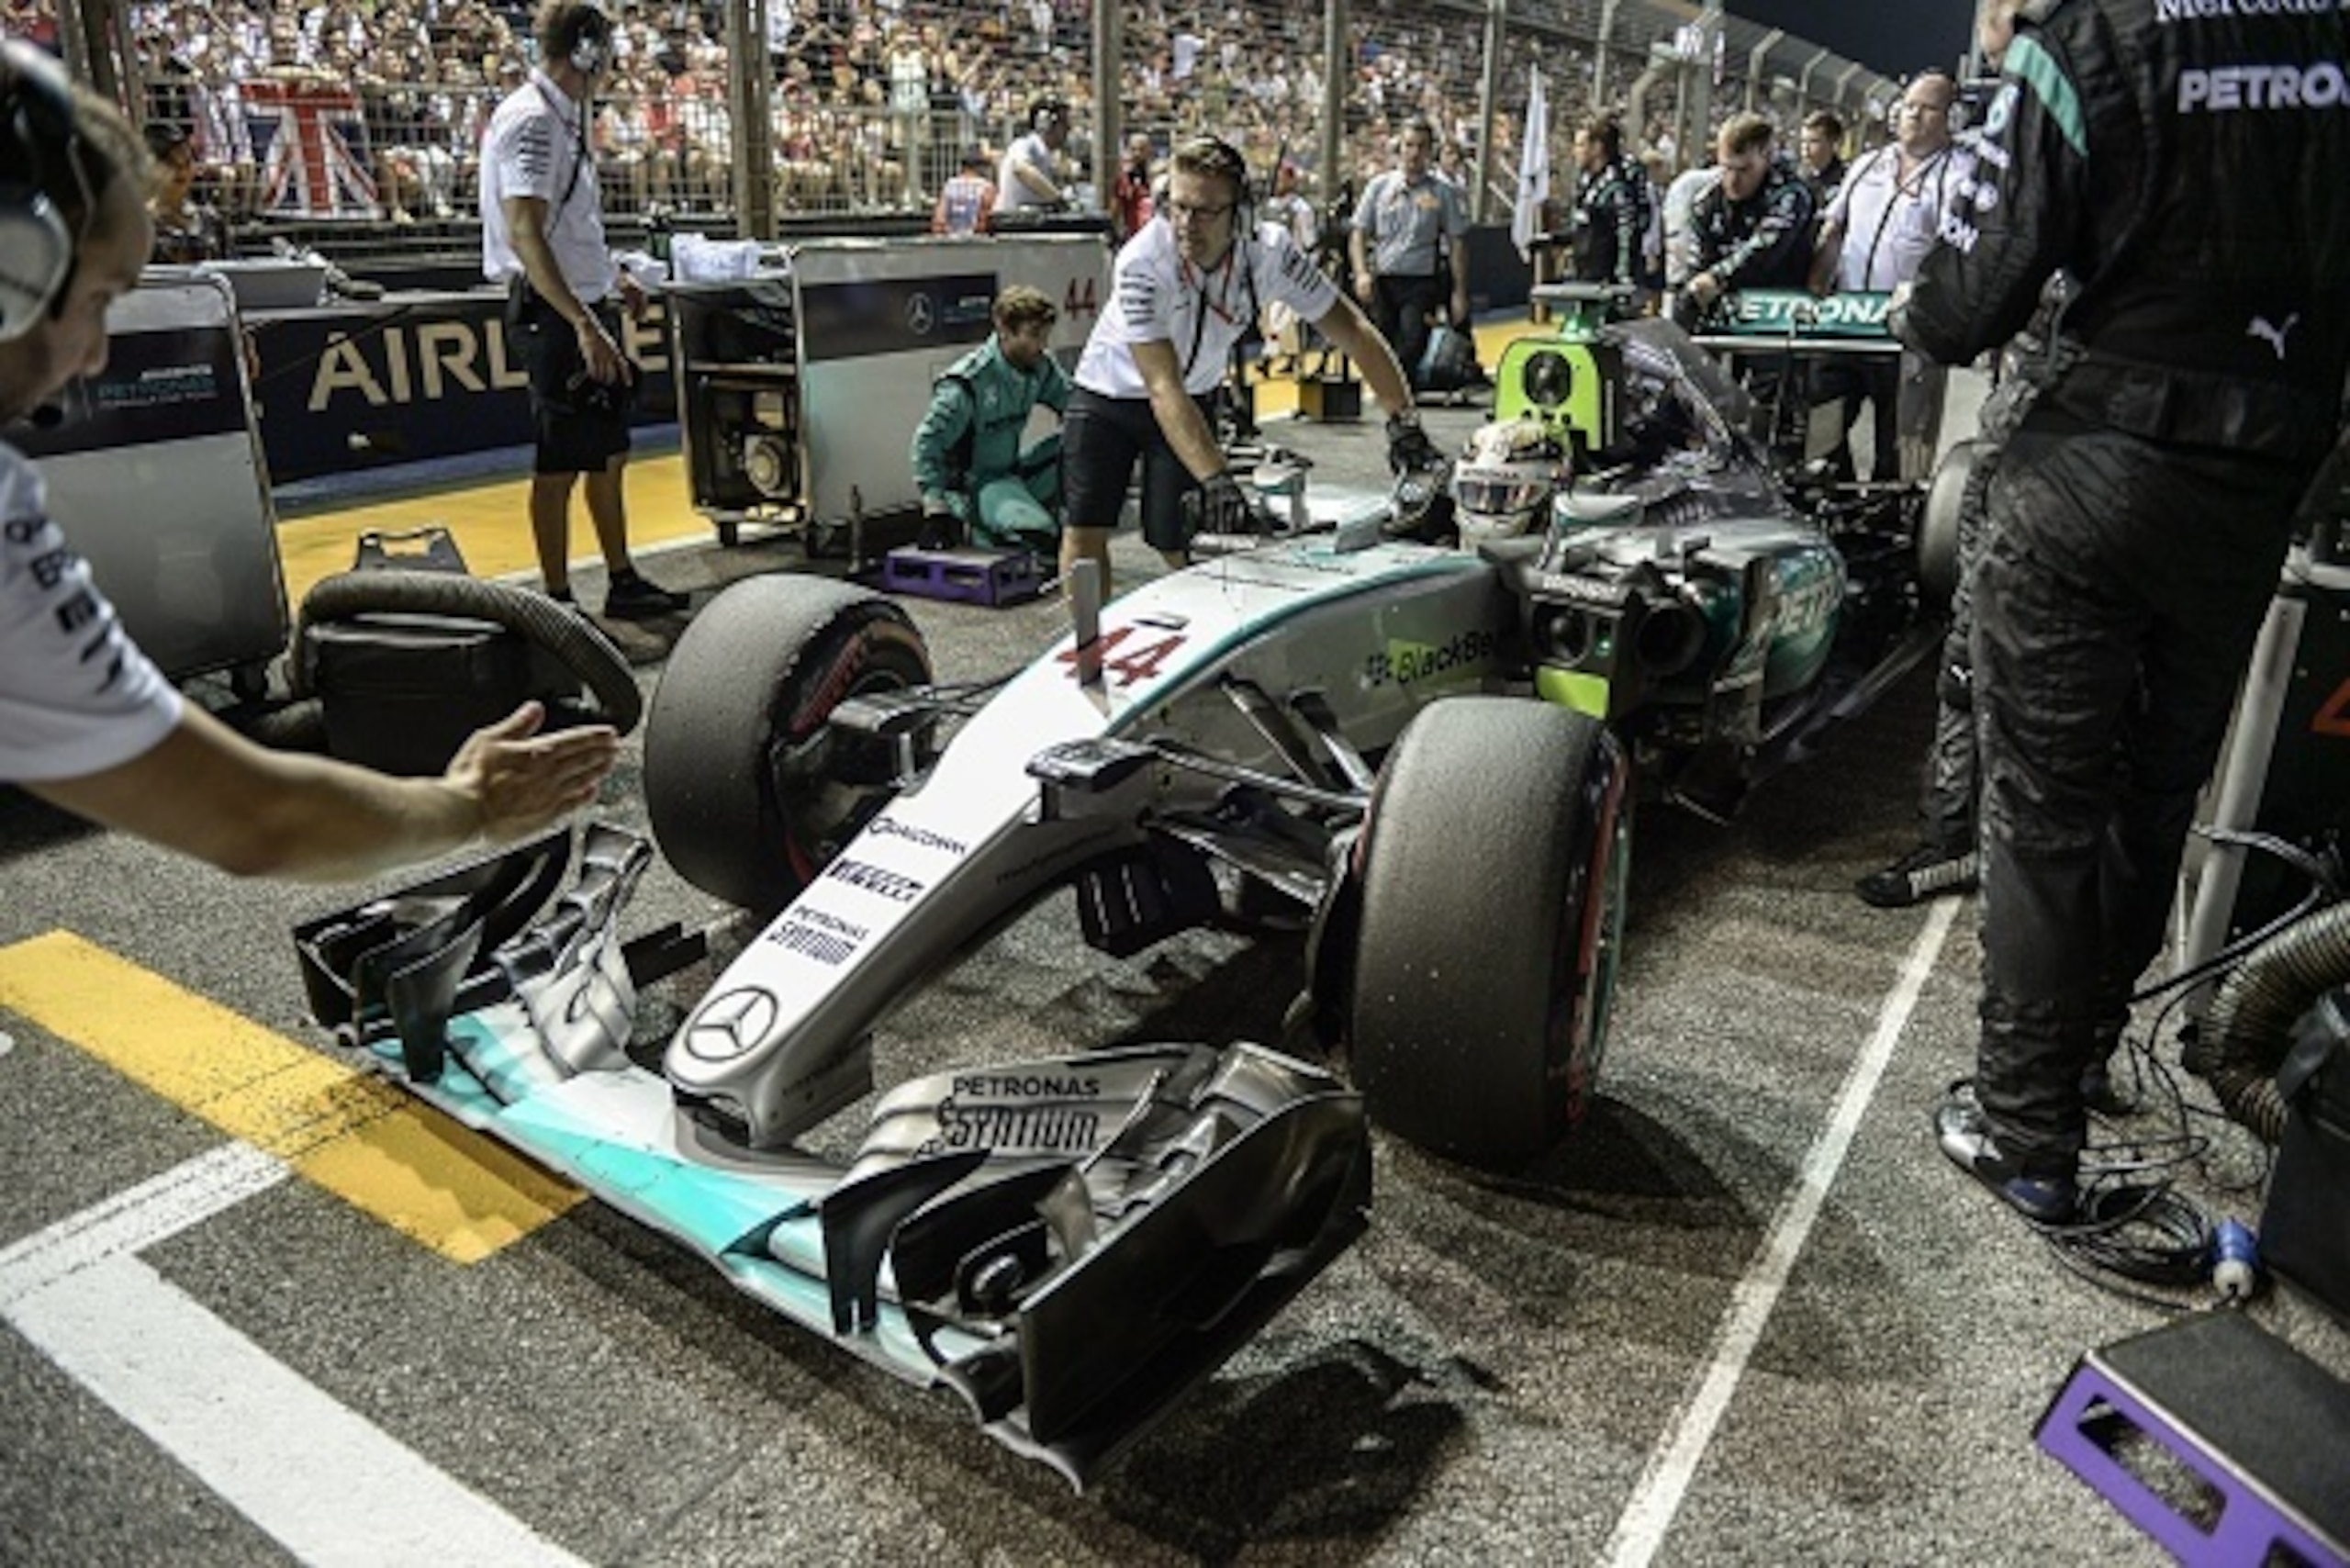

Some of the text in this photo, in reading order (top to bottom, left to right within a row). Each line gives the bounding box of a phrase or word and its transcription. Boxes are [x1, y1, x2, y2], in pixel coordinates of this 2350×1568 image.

[2177, 61, 2350, 115] PETRO
[1064, 277, 1096, 319] 44
[1737, 295, 1893, 324] ETRONA
[308, 304, 669, 411] AIRLE
[1057, 628, 1189, 687] 44
[1397, 632, 1494, 684] BlackBe
[827, 858, 925, 903] PIRELLI
[953, 1076, 1100, 1096] PETRONAS
